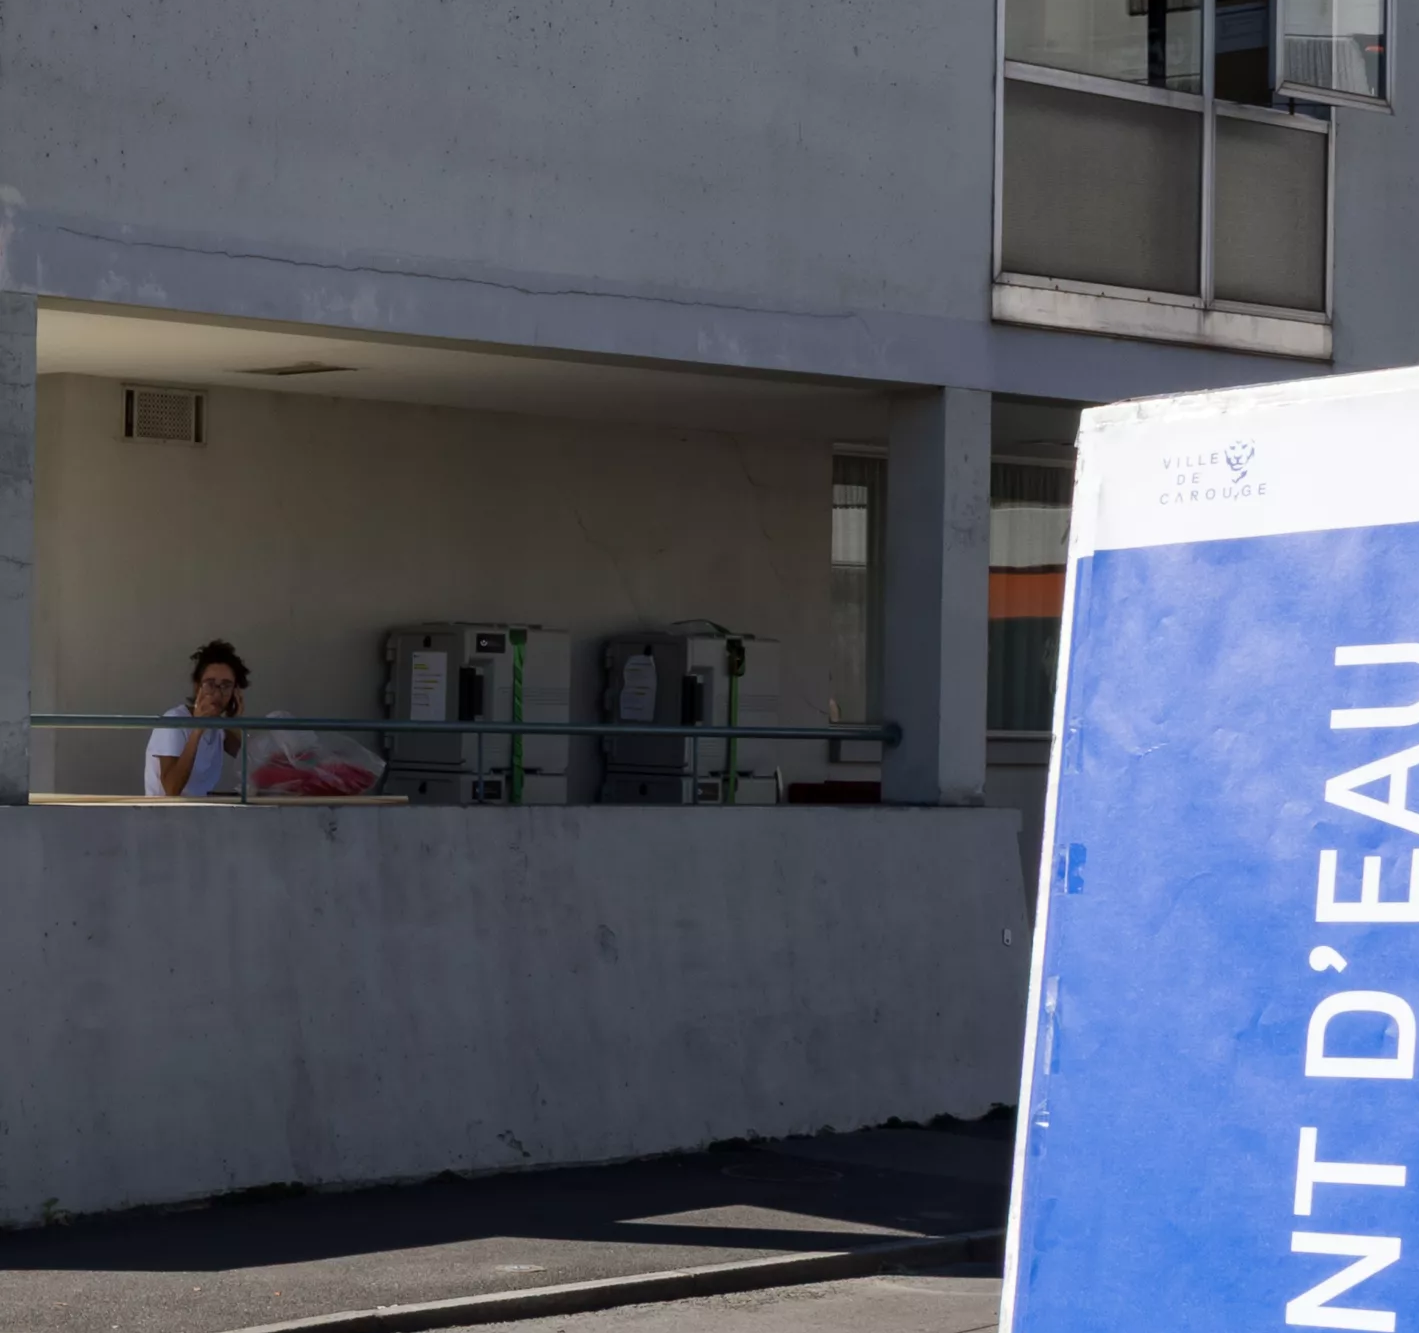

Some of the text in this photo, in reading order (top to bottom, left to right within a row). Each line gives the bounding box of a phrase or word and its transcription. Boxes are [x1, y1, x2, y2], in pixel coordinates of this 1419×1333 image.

[1163, 452, 1219, 470] VILLE
[1176, 472, 1200, 486] DE
[1159, 483, 1267, 505] CAROUGE
